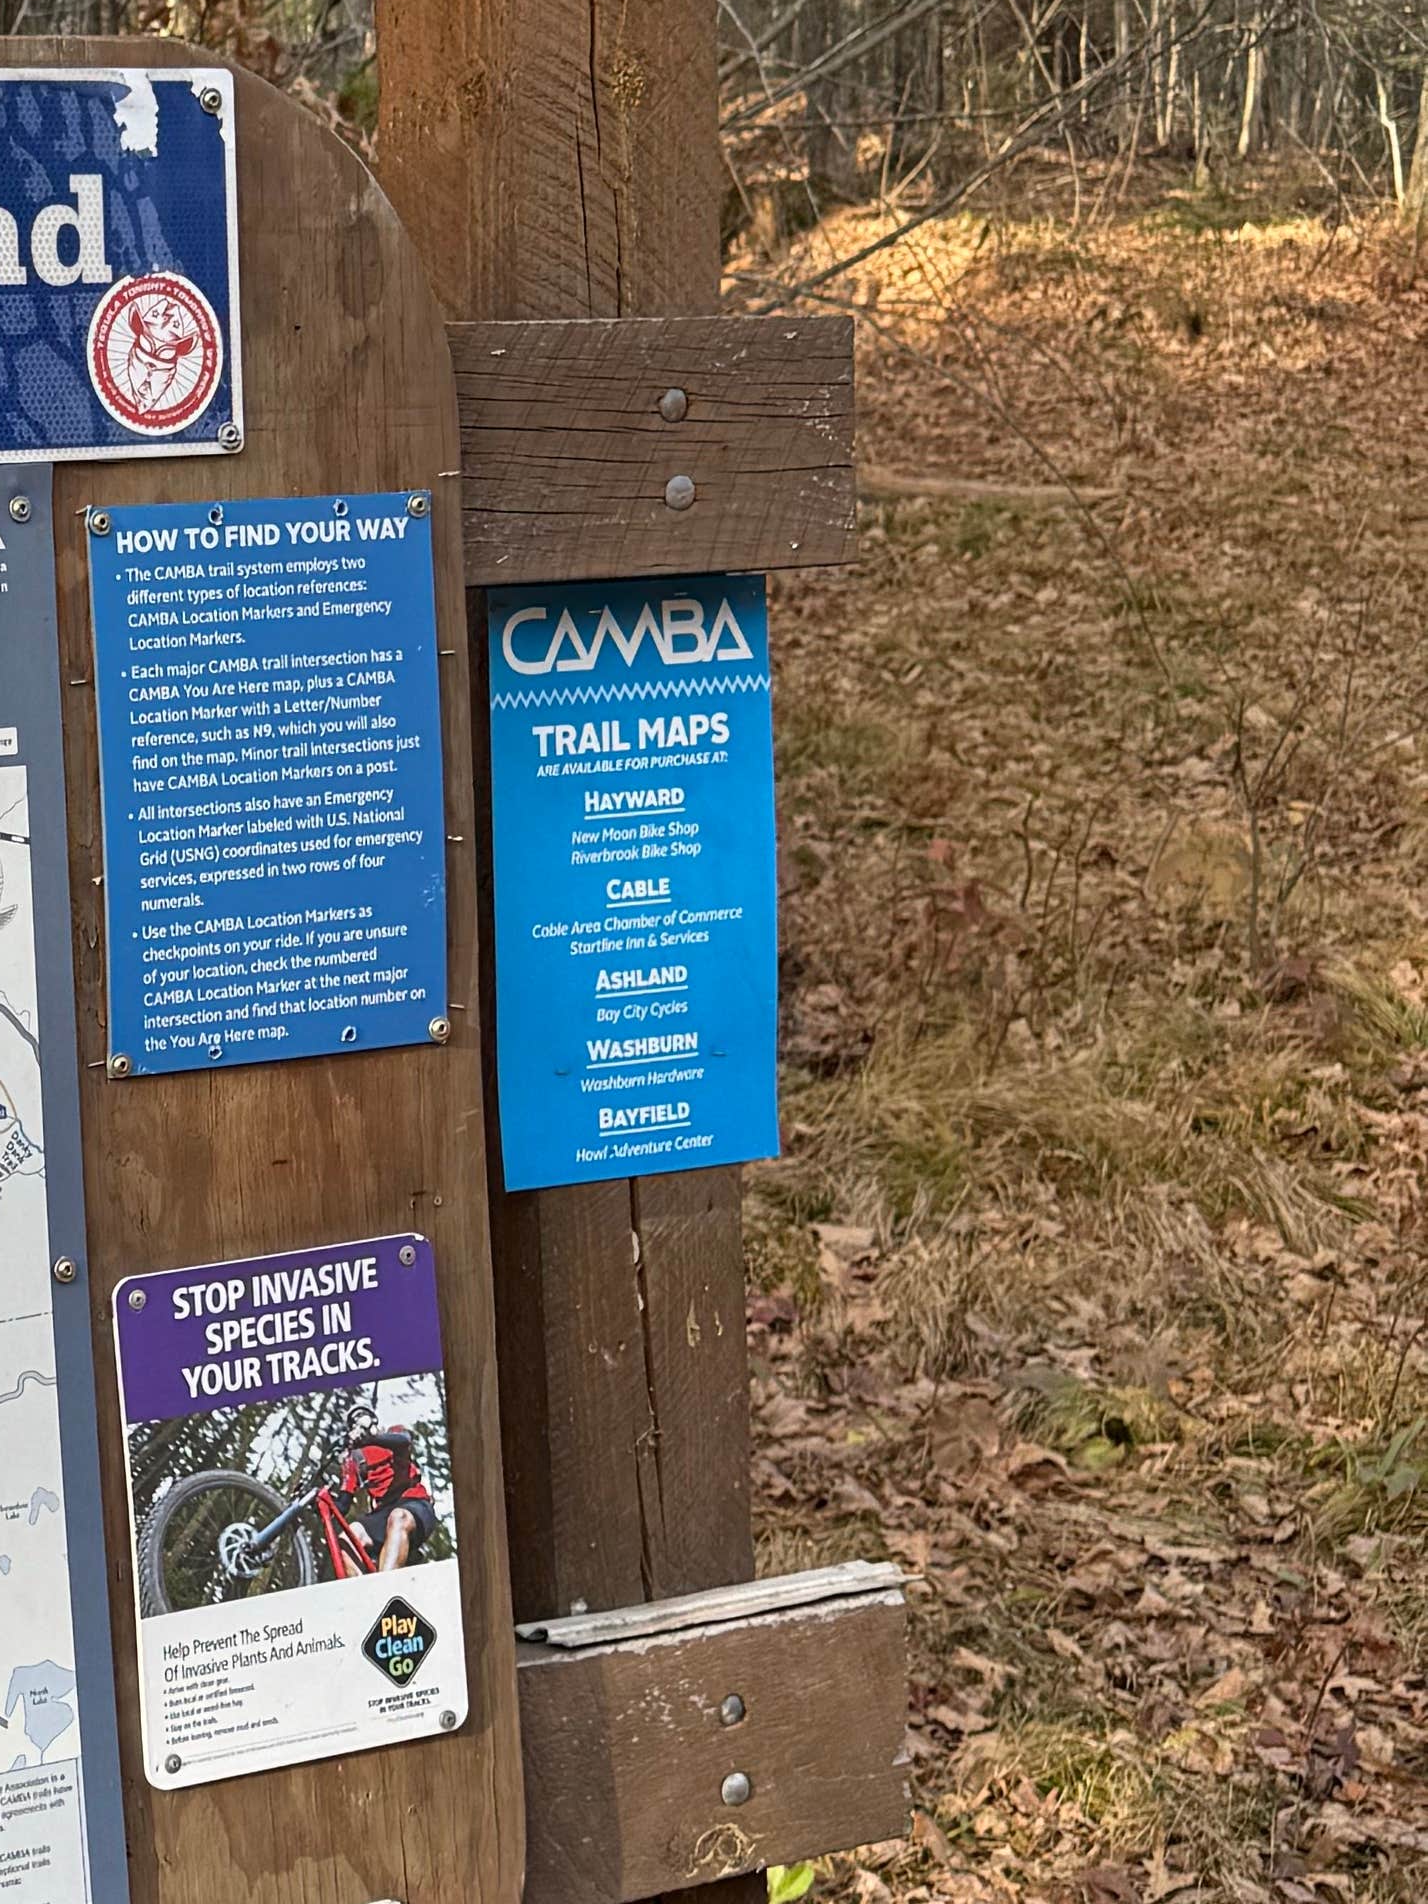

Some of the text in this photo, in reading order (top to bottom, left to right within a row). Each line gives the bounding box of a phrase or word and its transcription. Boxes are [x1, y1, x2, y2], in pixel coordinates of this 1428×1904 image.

[116, 516, 408, 553] HOW TO FIND YOUR WAY
[125, 557, 365, 582] The CAMBA trail system employs two
[502, 598, 753, 675] CAMBA
[532, 712, 729, 756] TRAIL MAPS
[596, 1000, 687, 1023] Bay City Cycles
[172, 1257, 378, 1319] STOP INVASIVE
[205, 1301, 351, 1354] SPECIES IN
[181, 1337, 380, 1398] YOUR TRACKS.
[163, 1618, 303, 1661] Help Prevent The Spread
[376, 1635, 424, 1659] Clean
[381, 1615, 417, 1637] Play
[164, 1633, 345, 1682] Of Invasive Plants And Animals.
[389, 1657, 414, 1676] Go
